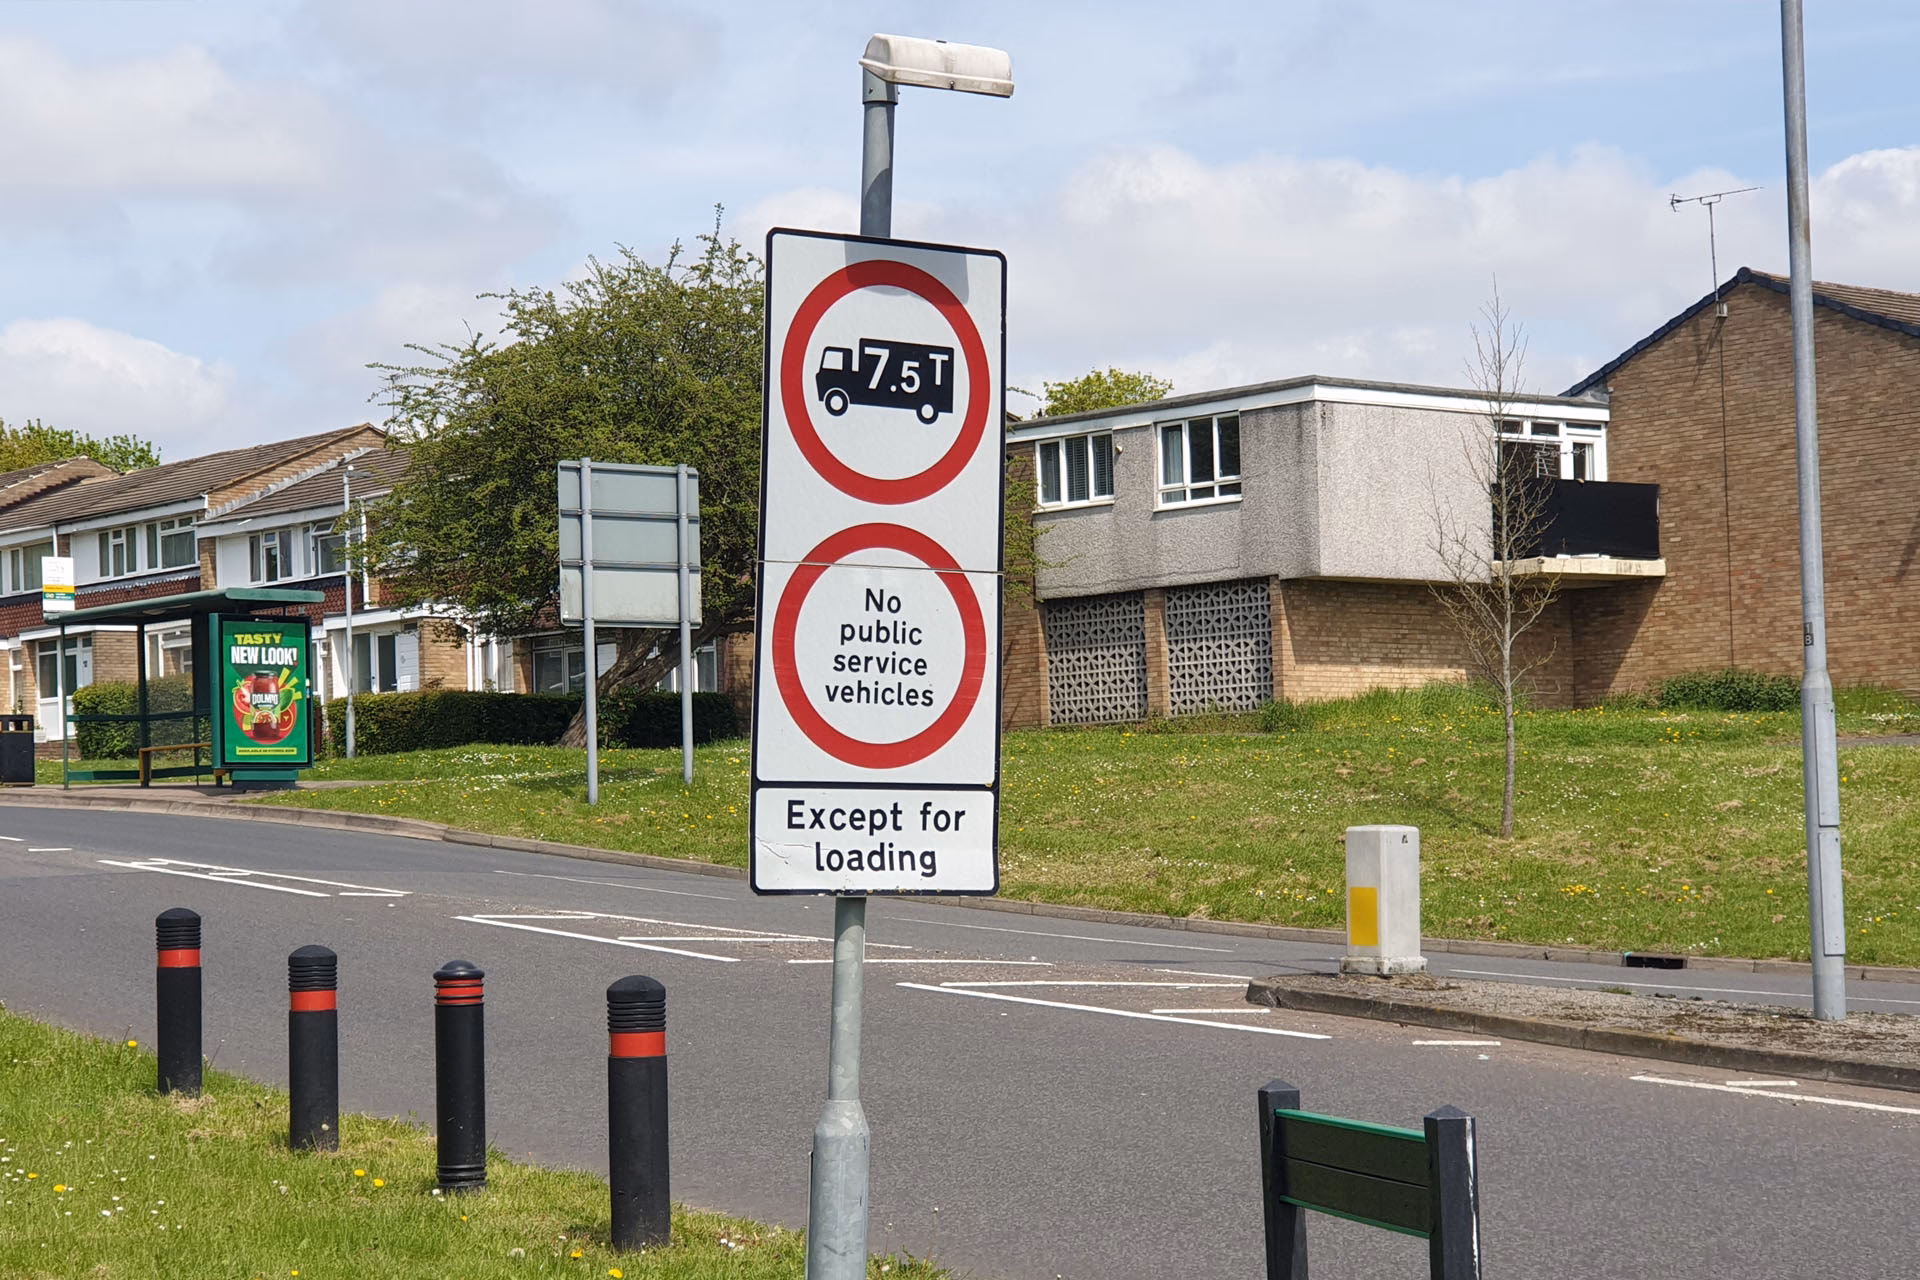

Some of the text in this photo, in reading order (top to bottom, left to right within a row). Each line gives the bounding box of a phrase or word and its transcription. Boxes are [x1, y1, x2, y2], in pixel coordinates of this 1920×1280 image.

[866, 588, 901, 613] No
[234, 633, 282, 645] TASTY
[841, 620, 921, 645] public
[231, 646, 298, 666] NEW LOOK!
[833, 655, 927, 675] service
[826, 680, 933, 706] vehicles
[788, 800, 965, 836] Except for
[816, 842, 936, 877] loading
